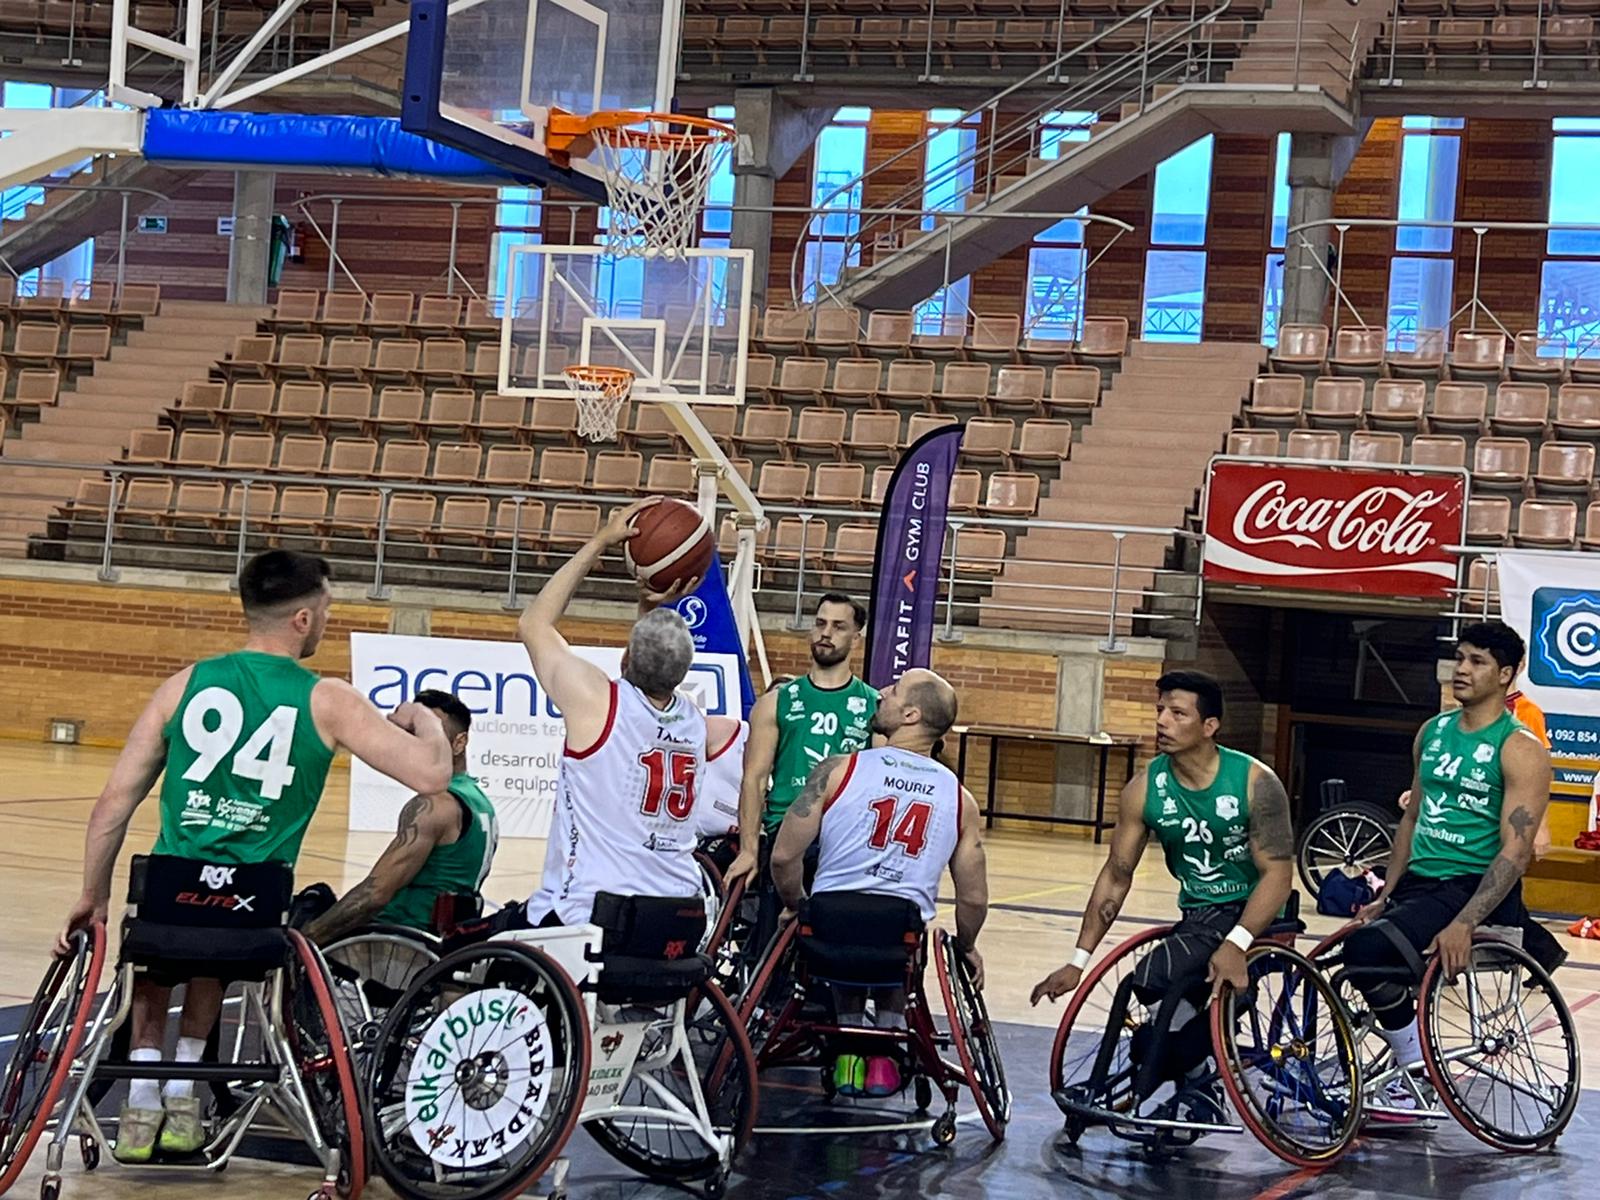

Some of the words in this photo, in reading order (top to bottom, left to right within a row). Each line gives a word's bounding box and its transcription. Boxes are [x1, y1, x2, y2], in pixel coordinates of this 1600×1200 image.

[911, 462, 931, 511] CLUB
[1233, 480, 1449, 555] Coca-Cola
[905, 519, 923, 561] GYM
[892, 600, 913, 680] LTAFIT
[471, 718, 538, 736] luciones
[810, 712, 838, 736] 20
[1555, 729, 1575, 742] 092
[1577, 731, 1598, 743] 854
[181, 686, 299, 800] 94
[481, 749, 559, 769] desarroll
[1433, 752, 1463, 780] 24
[504, 776, 559, 796] equipo
[637, 747, 698, 822] 15
[884, 776, 935, 796] MOURIZ
[1562, 773, 1594, 784] www.
[868, 794, 933, 859] 14
[1182, 817, 1214, 844] 26
[199, 865, 237, 890] RGK
[412, 998, 506, 1123] elkarbus
